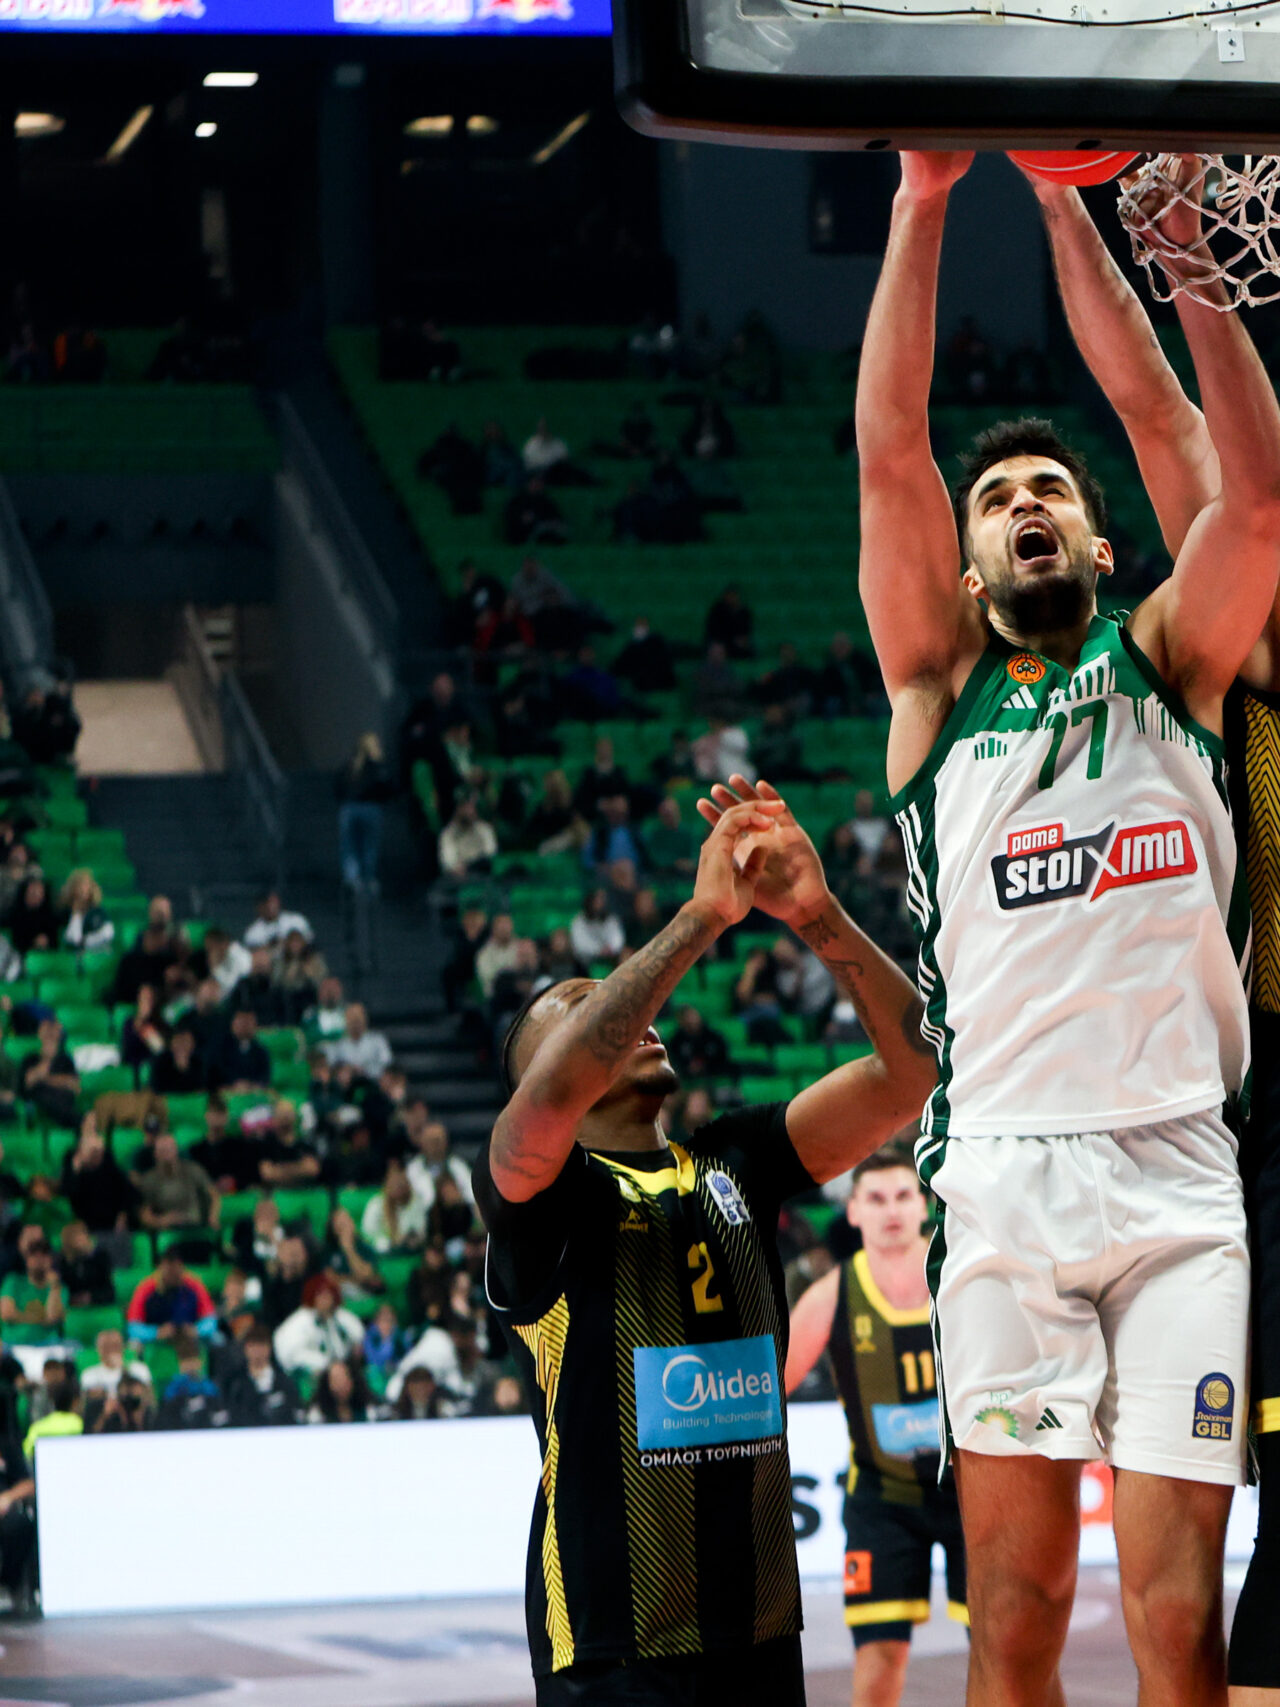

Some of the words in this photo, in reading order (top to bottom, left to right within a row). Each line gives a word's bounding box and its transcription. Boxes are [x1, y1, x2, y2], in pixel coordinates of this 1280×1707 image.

[1037, 698, 1109, 790] 77
[1011, 827, 1058, 855] pame
[687, 1241, 724, 1314] 2
[662, 1368, 772, 1412] Midea
[663, 1416, 709, 1430] Building
[1195, 1421, 1230, 1438] GBL
[640, 1450, 702, 1467] ΟΜΙΛΟΣ
